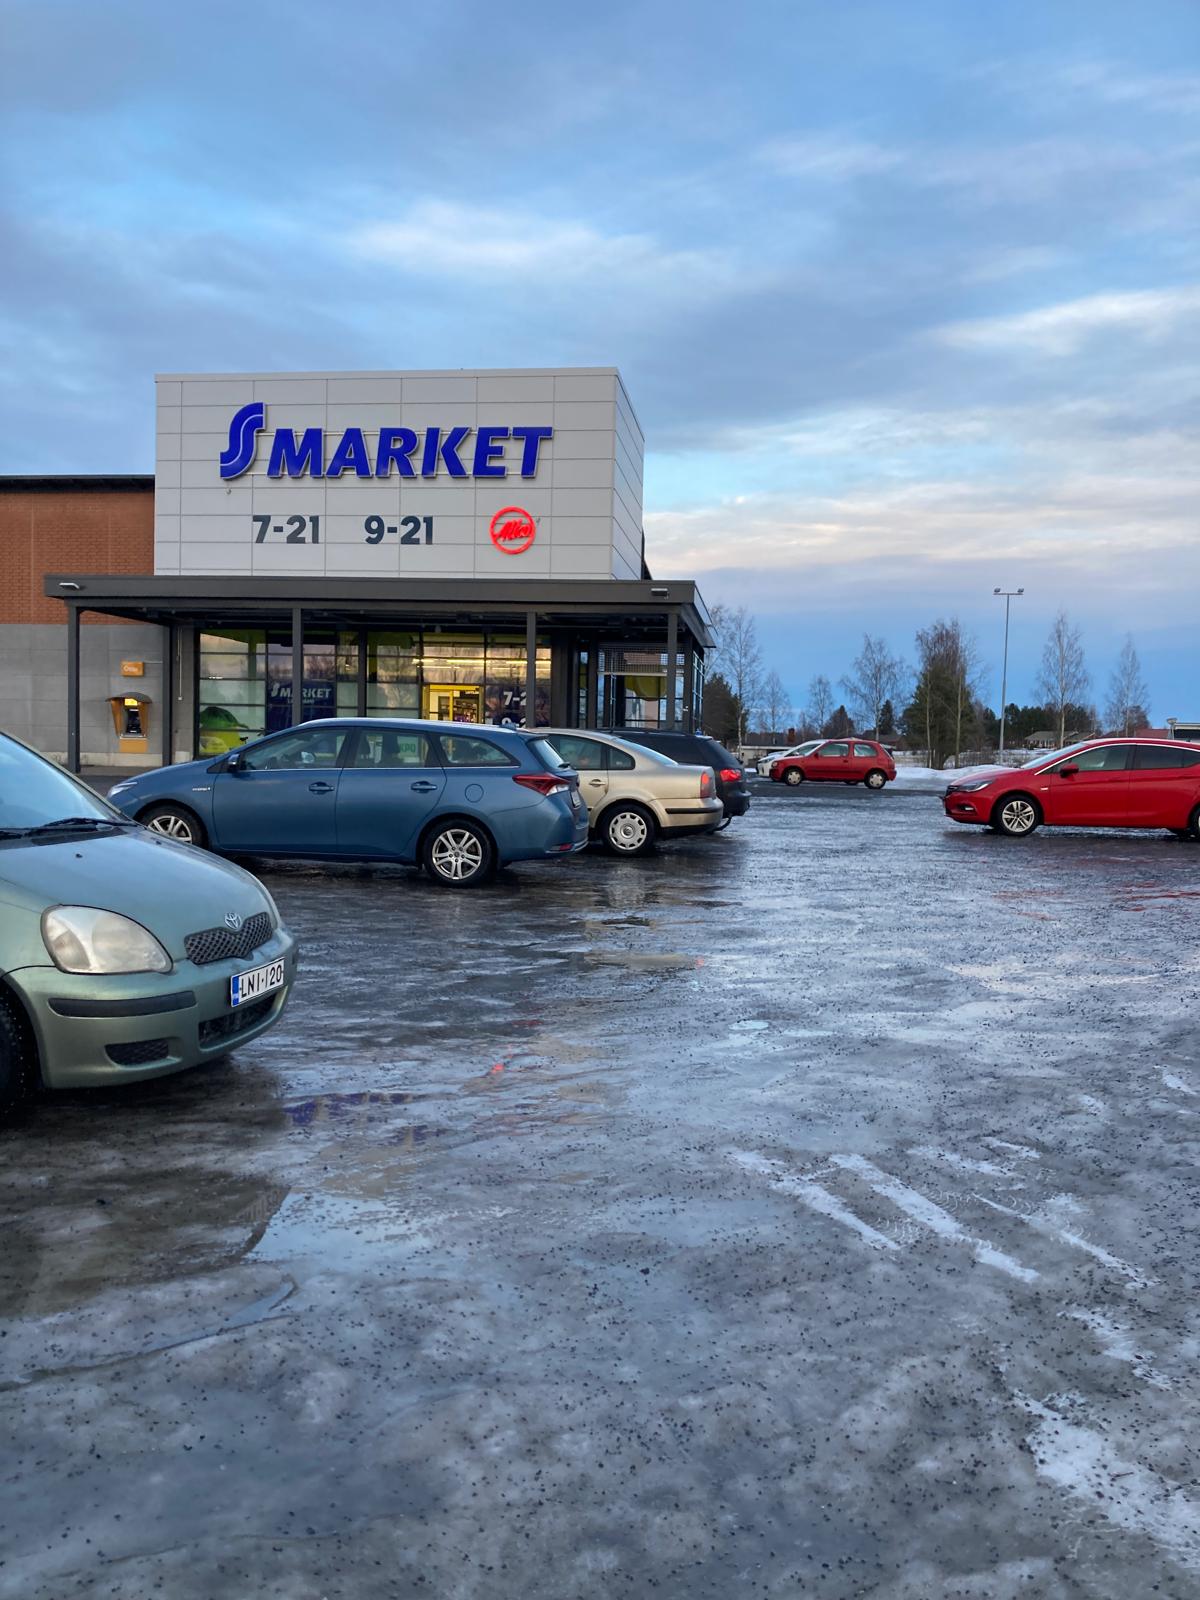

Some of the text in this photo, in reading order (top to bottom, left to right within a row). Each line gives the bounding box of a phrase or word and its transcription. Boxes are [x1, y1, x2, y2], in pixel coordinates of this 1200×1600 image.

[267, 426, 553, 479] MARKET
[252, 514, 320, 544] 7-21
[364, 514, 433, 545] 9-21
[280, 688, 331, 698] MRKET
[503, 691, 527, 706] 7-2
[241, 964, 282, 998] LNI-120
